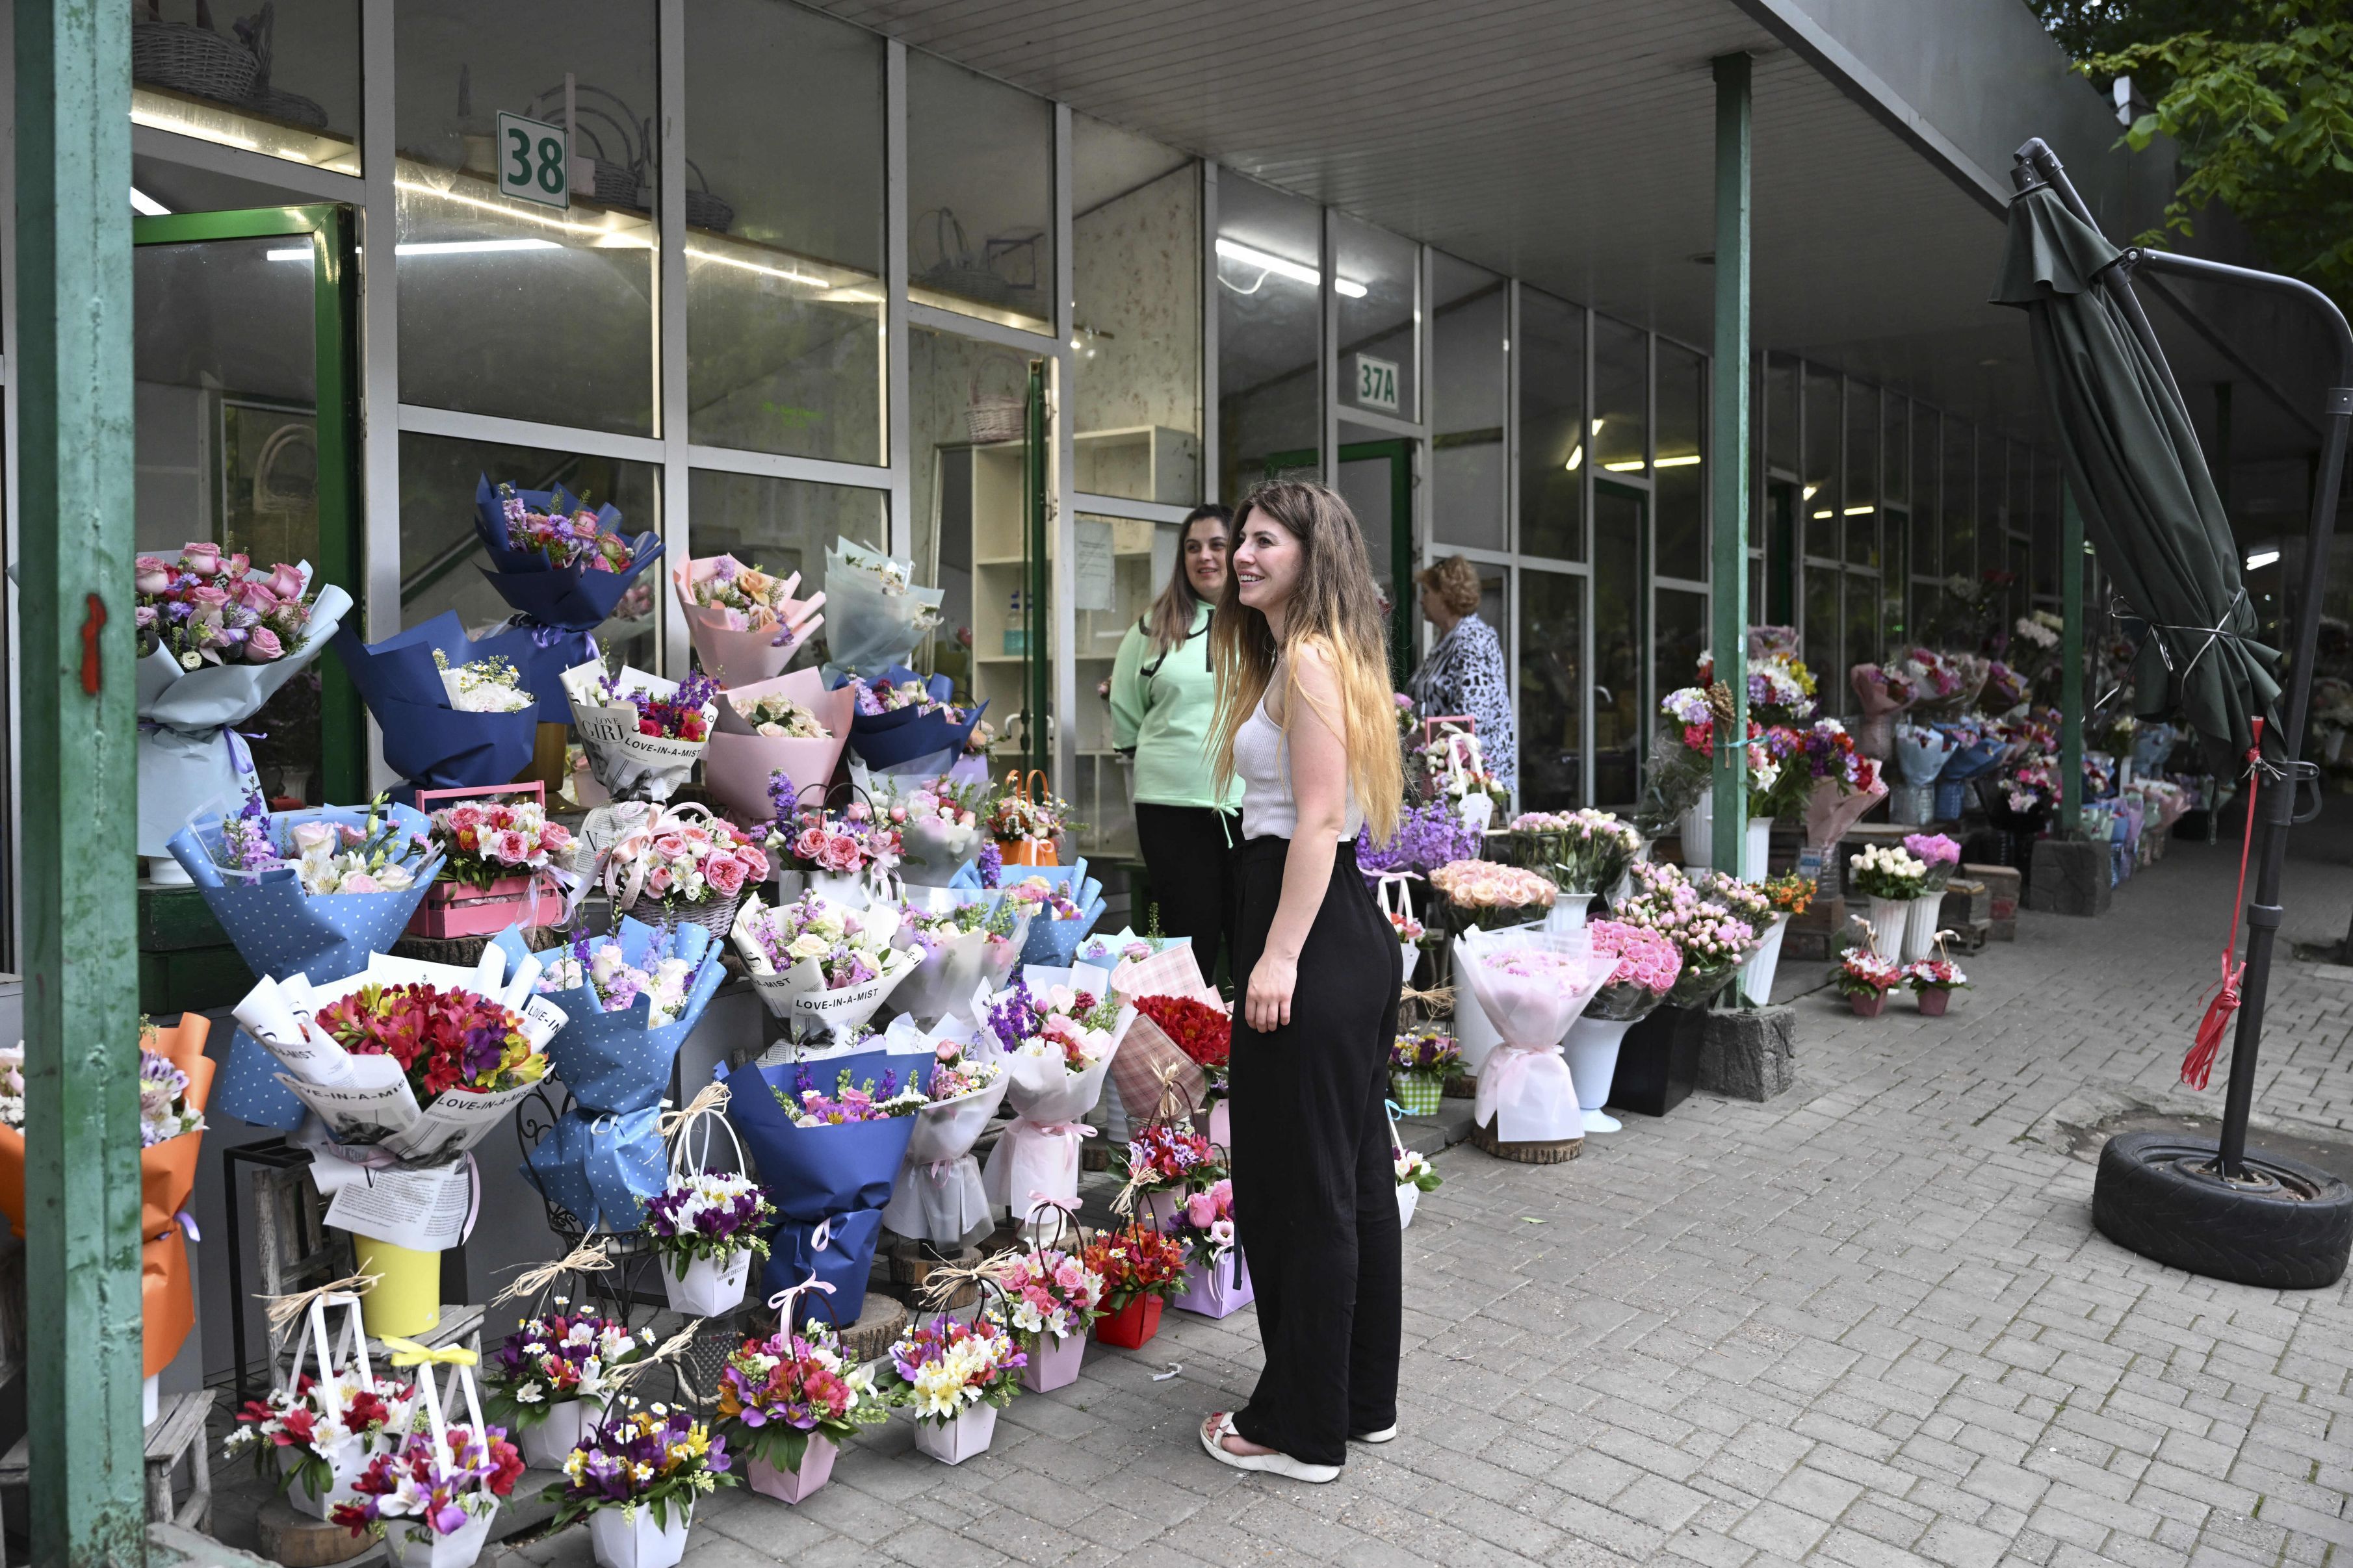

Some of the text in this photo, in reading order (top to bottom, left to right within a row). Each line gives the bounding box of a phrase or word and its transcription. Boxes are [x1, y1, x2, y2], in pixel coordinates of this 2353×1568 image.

[507, 127, 565, 194] 38
[1362, 364, 1395, 404] 37A
[624, 738, 701, 758] LOVE-IN-A-MIST
[796, 988, 879, 1010] LOVE-IN-A-MIST
[437, 1088, 531, 1110] LOVE-IN-A-MIS
[717, 1272, 730, 1282] HOME
[731, 1265, 746, 1276] DECOR
